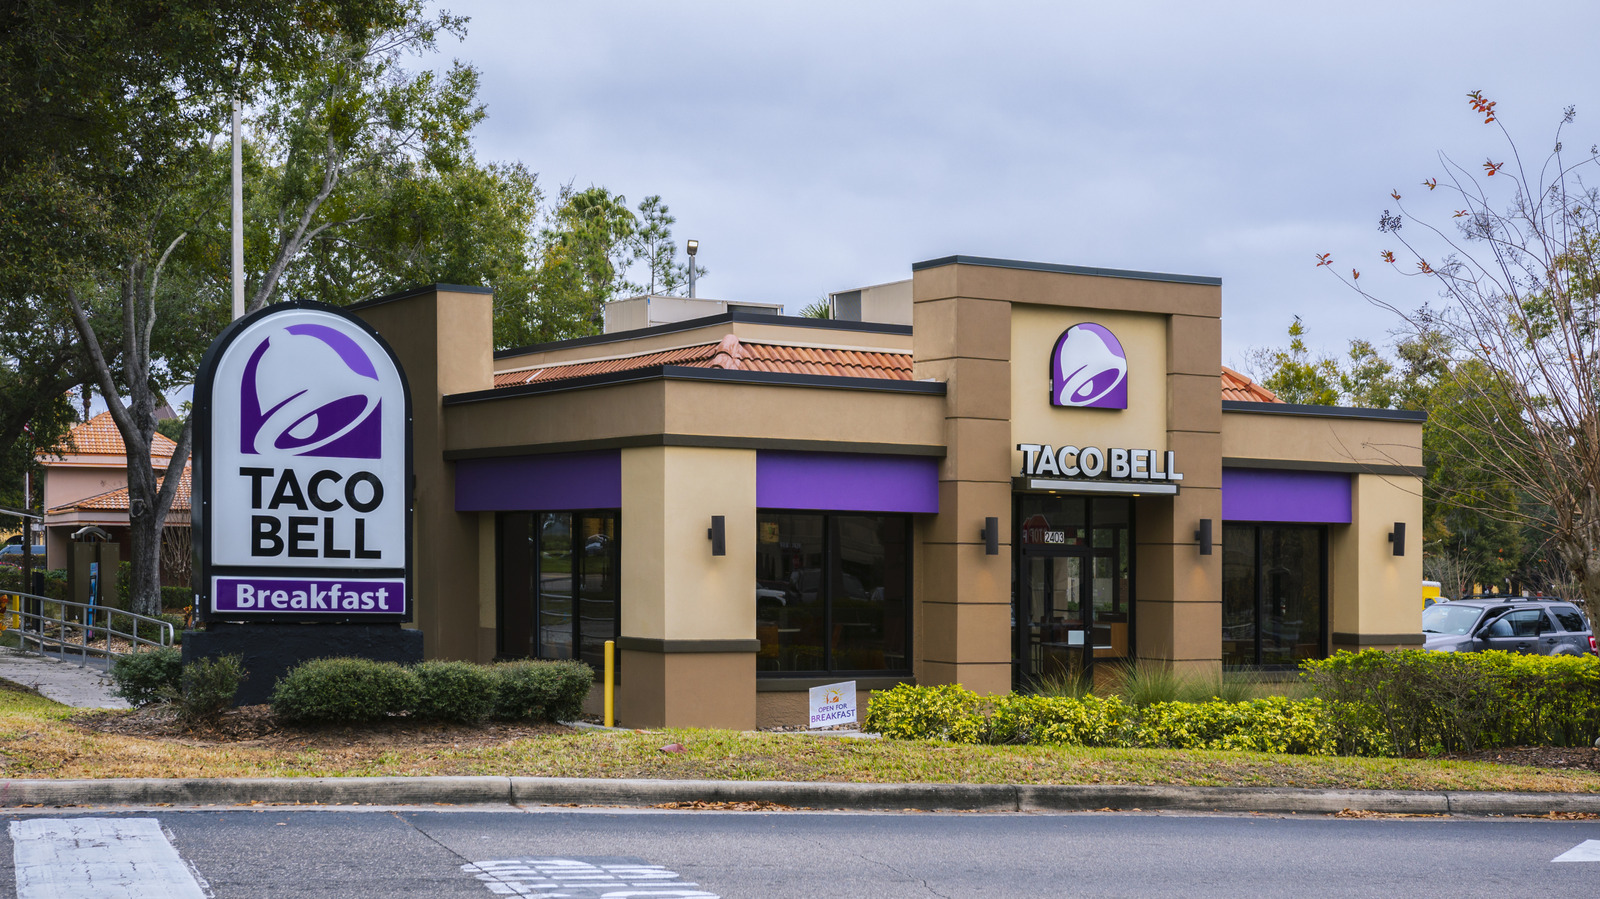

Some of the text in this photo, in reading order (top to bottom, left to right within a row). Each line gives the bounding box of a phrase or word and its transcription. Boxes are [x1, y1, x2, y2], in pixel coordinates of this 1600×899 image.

[1017, 443, 1184, 480] TACO BELL
[239, 466, 384, 513] TACO
[251, 515, 382, 559] BELL
[1045, 532, 1064, 543] 2403
[236, 583, 389, 610] Breakfast
[811, 709, 856, 723] BREAKFAST
[818, 703, 847, 713] OPEN FOR
